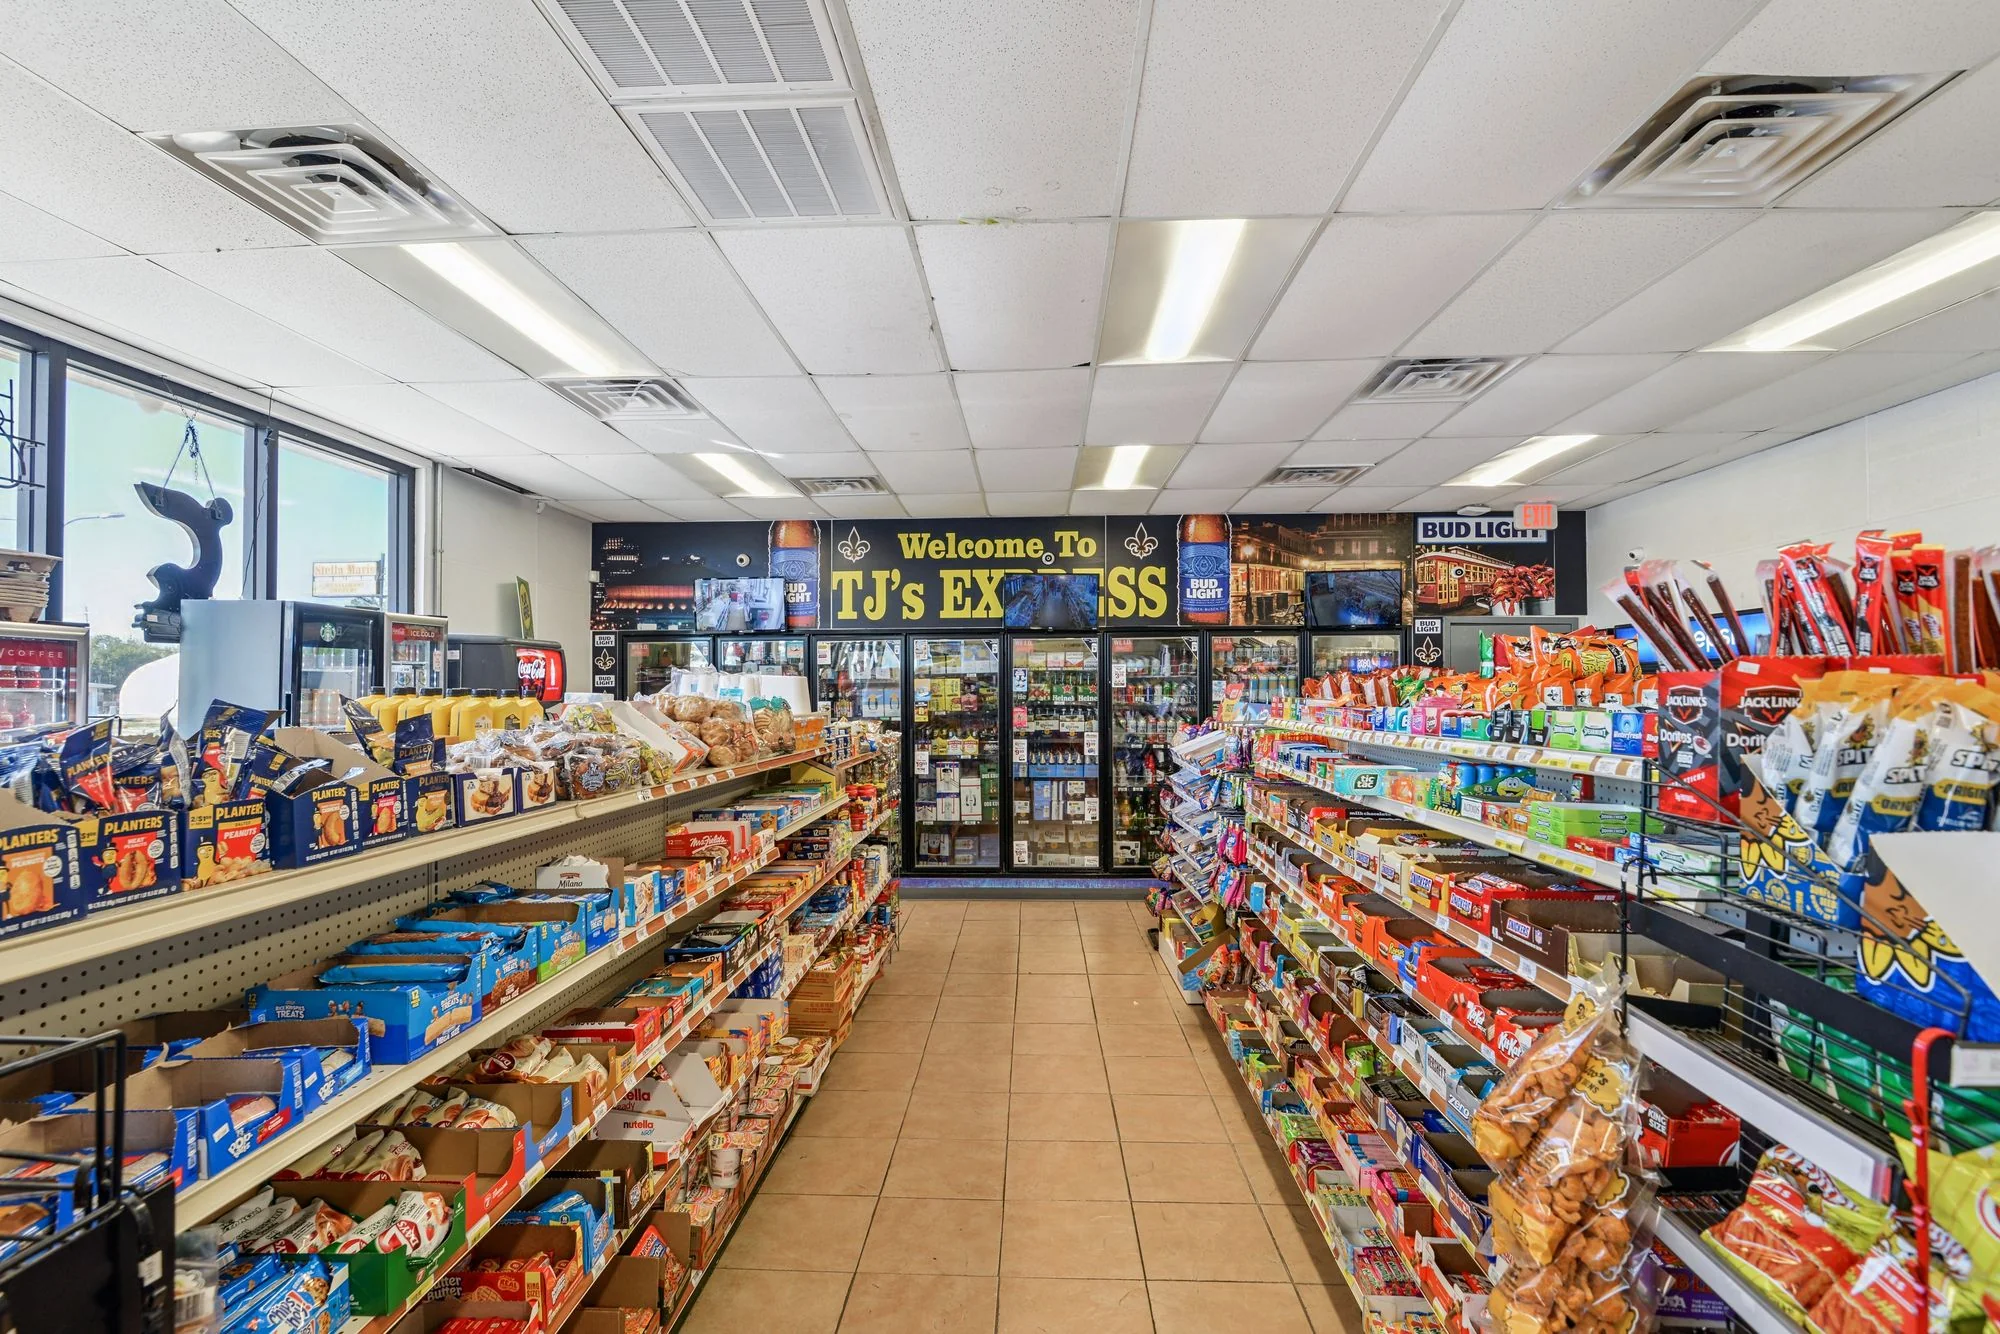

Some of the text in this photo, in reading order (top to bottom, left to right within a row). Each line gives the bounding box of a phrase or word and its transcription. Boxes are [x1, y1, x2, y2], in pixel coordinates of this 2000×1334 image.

[1523, 504, 1552, 527] EXIT
[1422, 521, 1471, 538] BUD
[898, 530, 1098, 559] Welcome To
[1190, 578, 1218, 588] BUD
[785, 592, 812, 602] GHT
[832, 566, 1168, 620] TJ's EXSS
[1186, 588, 1223, 599] LIGHT
[1693, 628, 1736, 652] epsi
[7, 649, 63, 659] COFFEE
[1738, 696, 1801, 709] JACK LINK
[1660, 728, 1692, 744] Doritos
[1726, 733, 1767, 747] Dorit
[1883, 764, 1928, 784] SPIT
[312, 787, 346, 801] PLANTERS
[372, 780, 400, 793] PLANTERS
[215, 802, 264, 820] PLANTERS
[104, 816, 164, 836] PLANTERS
[223, 827, 257, 840] PEANUTS
[557, 879, 583, 889] Milano
[1409, 872, 1432, 892] SNICKERS
[1507, 919, 1530, 937] SNICKERS
[276, 1011, 305, 1019] TREATS
[624, 1088, 651, 1101] ella
[1647, 1107, 1667, 1123] KING
[623, 1120, 654, 1128] nutella
[1648, 1119, 1667, 1135] SIZE
